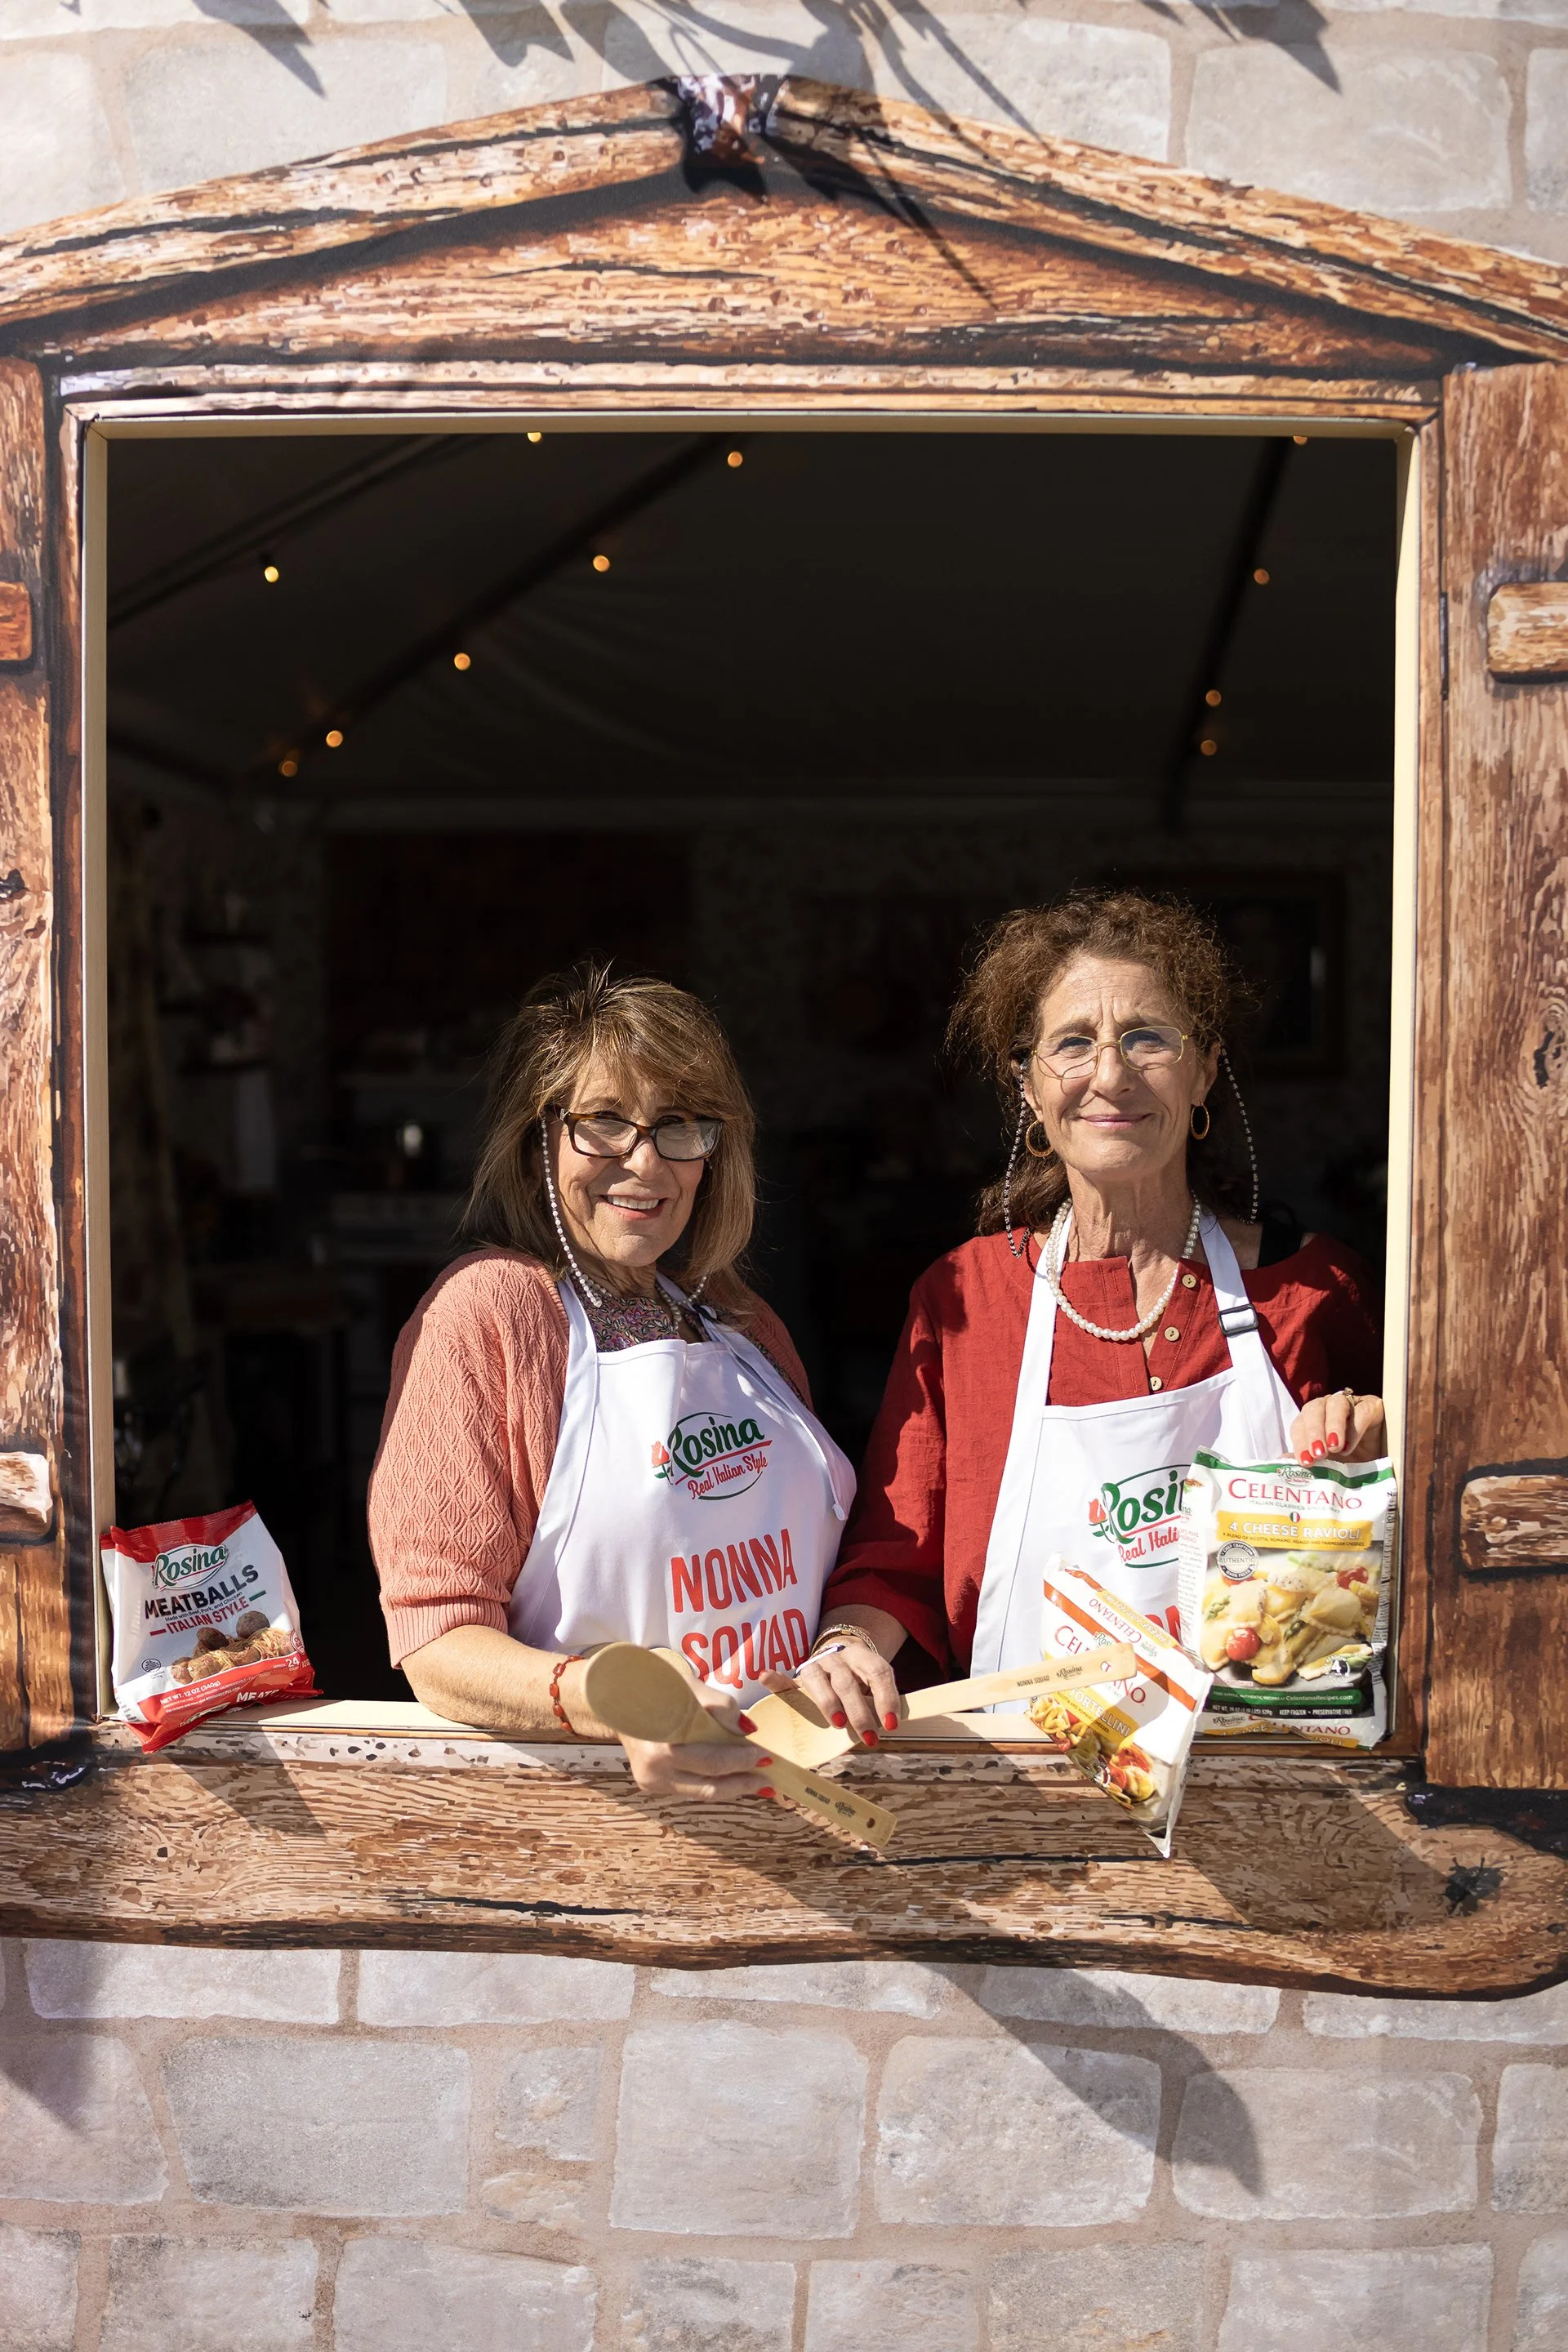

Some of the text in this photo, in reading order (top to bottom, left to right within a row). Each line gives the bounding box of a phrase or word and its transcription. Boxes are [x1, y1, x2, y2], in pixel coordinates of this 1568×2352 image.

[667, 1416, 765, 1477] Rosina
[688, 1450, 768, 1500] Real Italian Style
[1281, 1466, 1313, 1480] Rosina
[1100, 1470, 1187, 1544] Rosi
[1228, 1478, 1362, 1510] CELENTANO
[1118, 1526, 1179, 1563] Real Itali
[1229, 1521, 1361, 1540] 4 CHEESE RAVIOLI
[154, 1546, 227, 1587] Rosina
[670, 1528, 798, 1613] NONNA
[145, 1564, 259, 1619] MEATBALLS
[223, 1592, 243, 1605] Chicken
[167, 1596, 249, 1633] ITALIAN STYLE
[1089, 1598, 1143, 1643] CELENTANO
[286, 1657, 299, 1668] 24
[681, 1608, 809, 1689] SQUAD
[160, 1695, 172, 1704] NET
[201, 1681, 220, 1691] (340g)
[1017, 1677, 1034, 1687] NONNA
[1034, 1674, 1049, 1684] SQUAD
[1069, 1688, 1131, 1738] TORTELLINI
